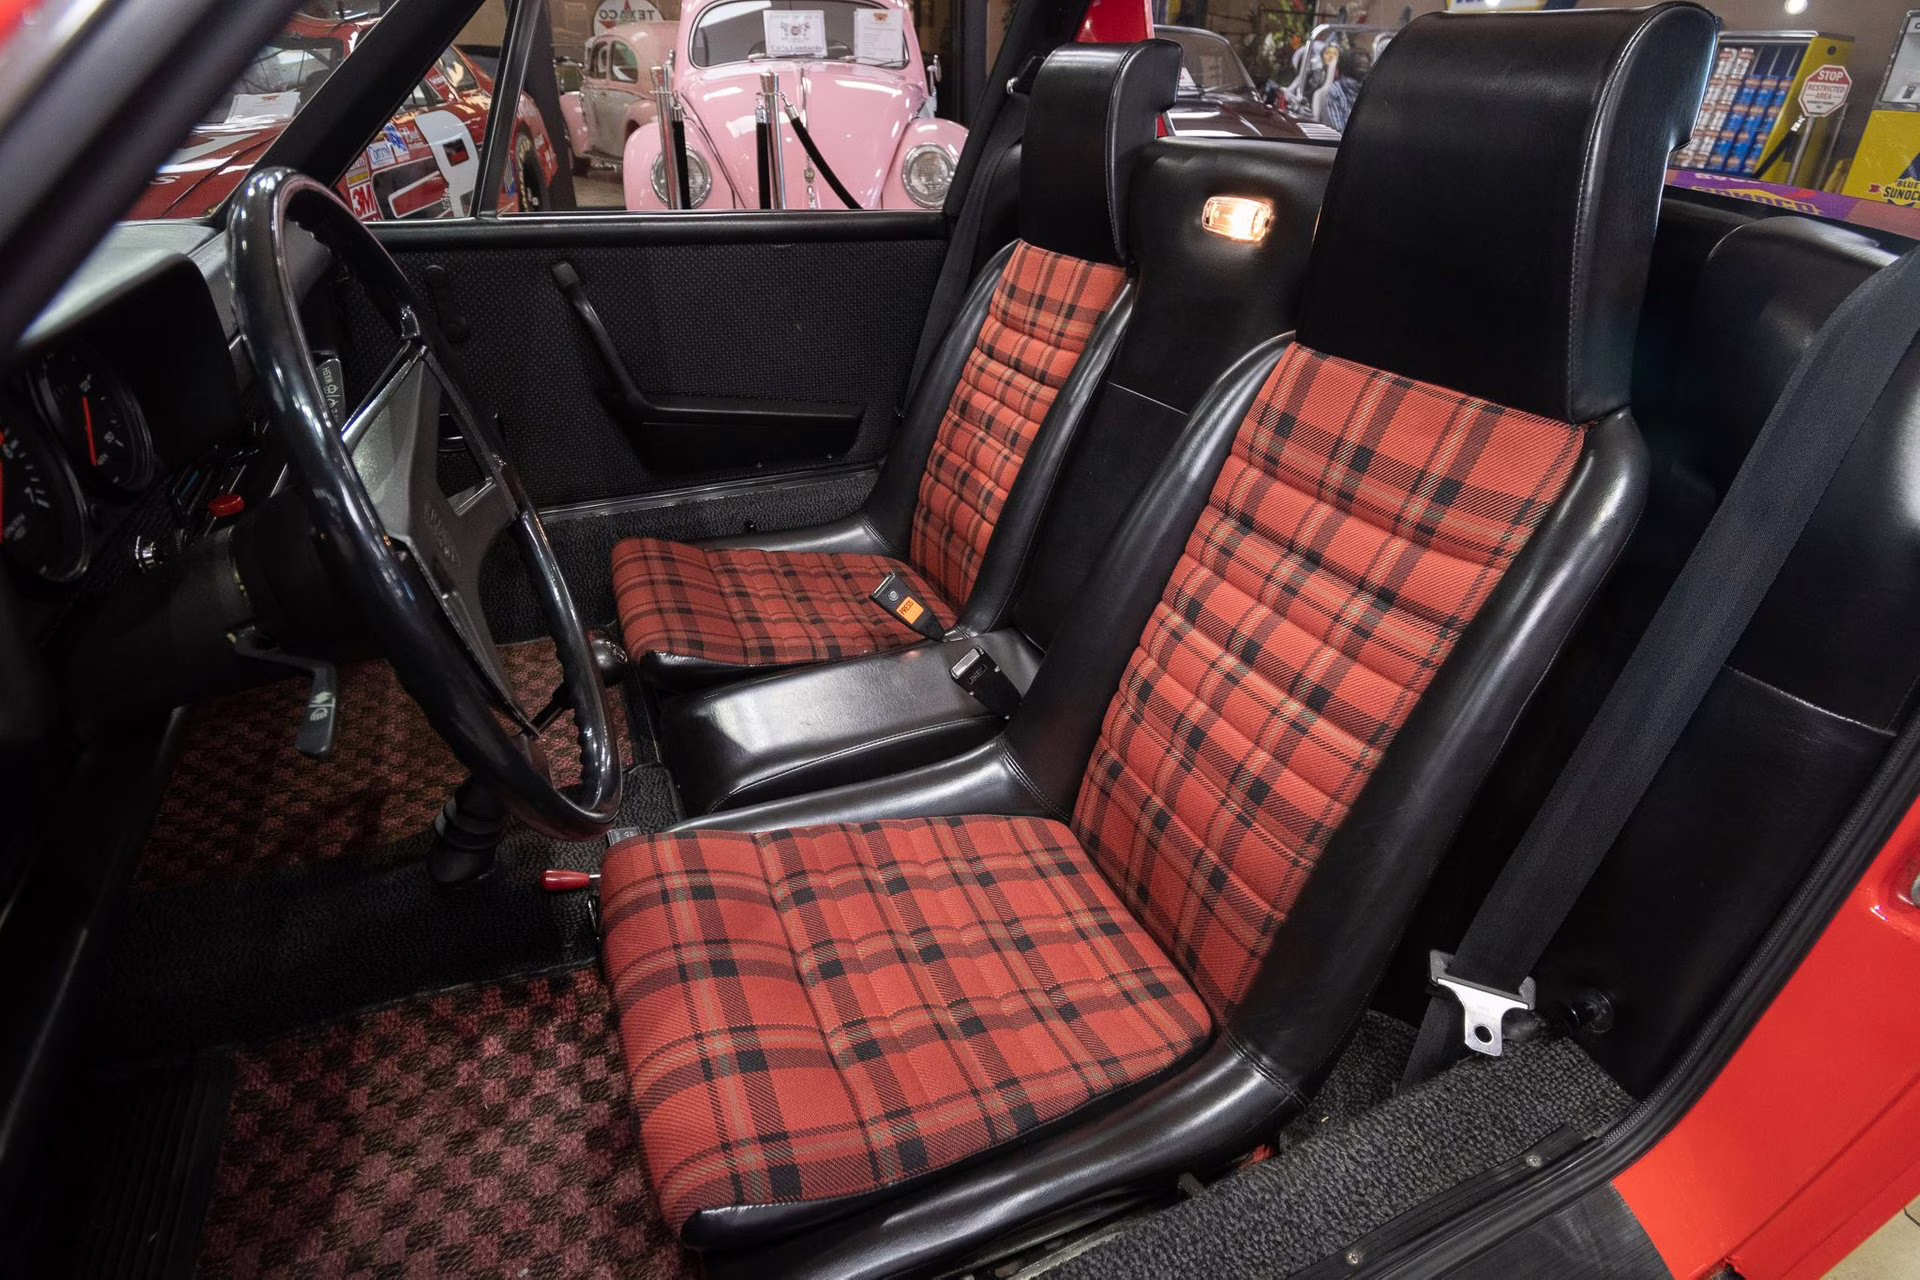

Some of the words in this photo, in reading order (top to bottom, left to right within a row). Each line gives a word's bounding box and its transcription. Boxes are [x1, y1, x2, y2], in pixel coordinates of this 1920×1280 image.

[1817, 70, 1844, 81] STOP
[1807, 83, 1845, 93] RESTRICTED
[1896, 180, 1920, 189] BLUE
[1883, 186, 1920, 201] SUNOC
[900, 601, 913, 615] PRESS
